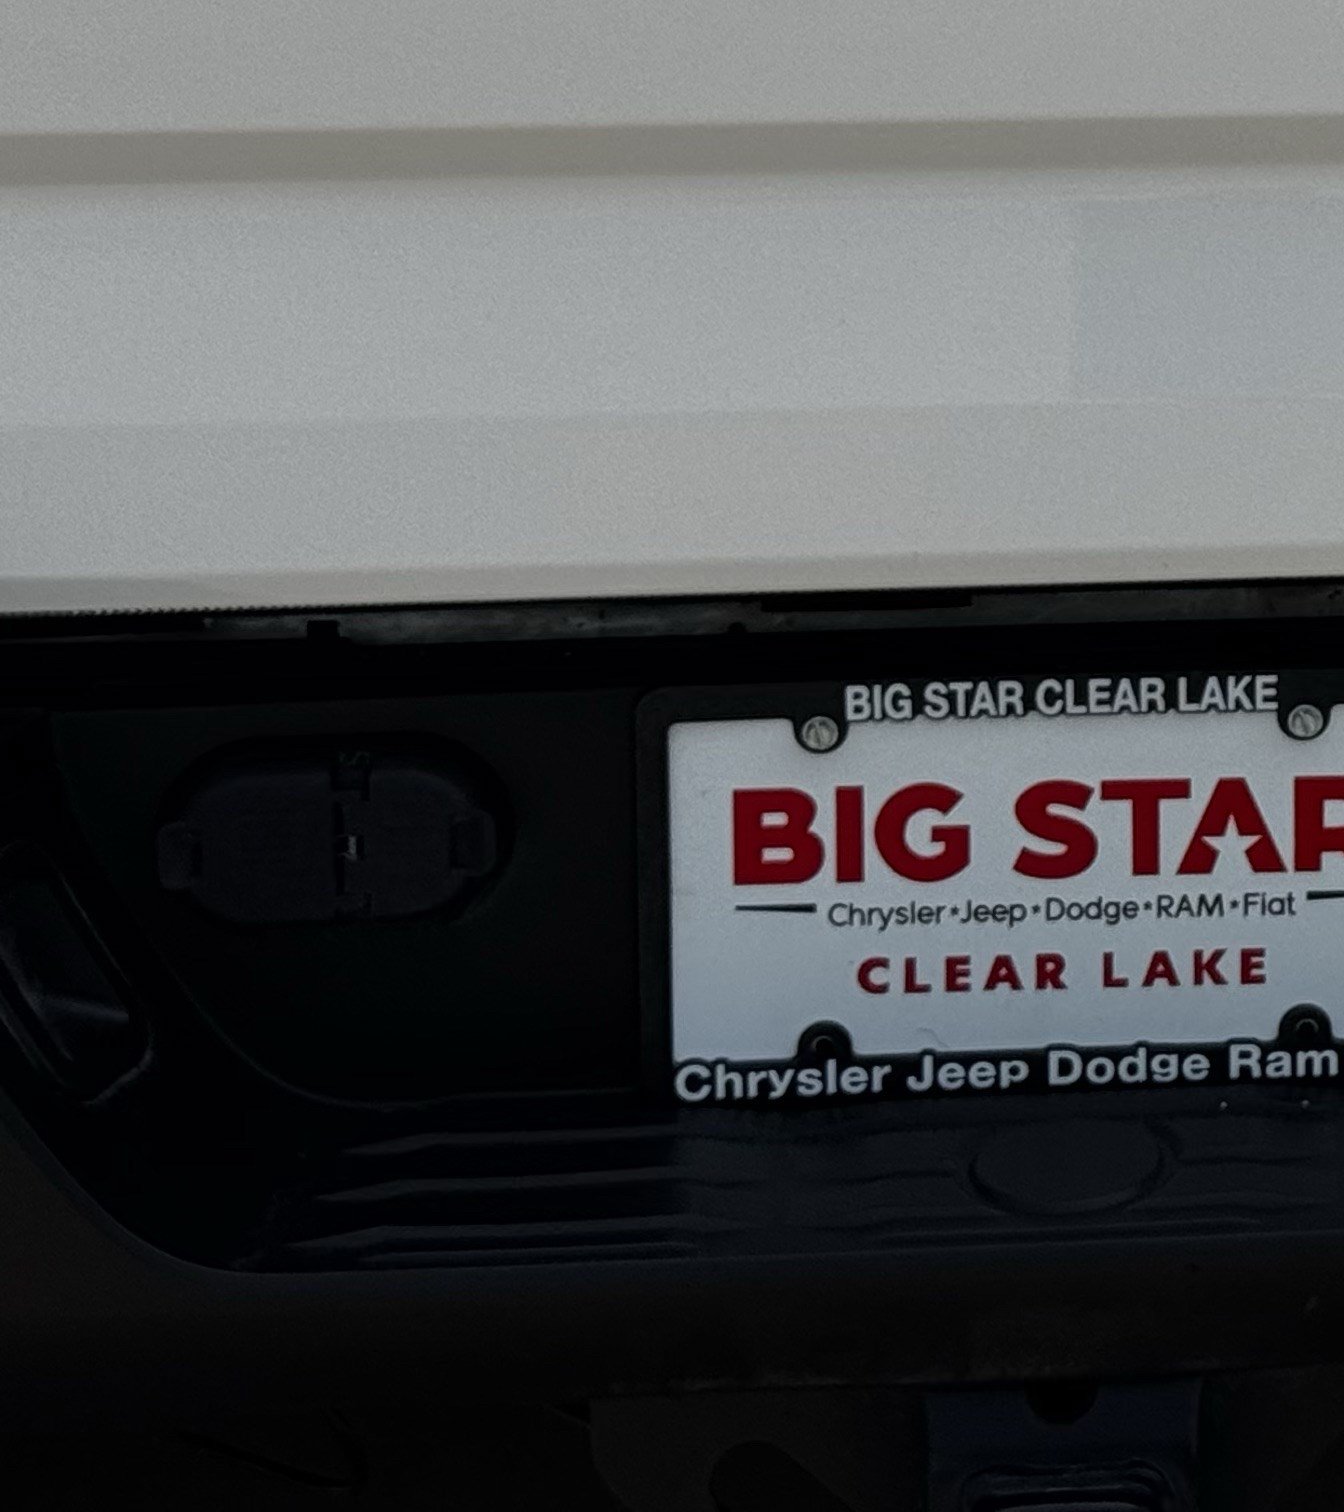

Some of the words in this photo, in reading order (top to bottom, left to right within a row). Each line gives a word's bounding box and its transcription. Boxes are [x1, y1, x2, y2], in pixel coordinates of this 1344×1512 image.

[845, 684, 913, 722] BIG
[924, 680, 1025, 720] STAR
[1035, 676, 1166, 716] CLEAR
[1177, 673, 1279, 712] LAKE
[732, 781, 971, 886] BIG
[856, 953, 1068, 994] CLEAR
[1102, 947, 1267, 988] LAKE
[674, 1059, 892, 1103] Chrysler
[906, 1054, 1030, 1091] Jeep
[1047, 1046, 1211, 1086] Dodge
[1229, 1043, 1339, 1080] Ram
